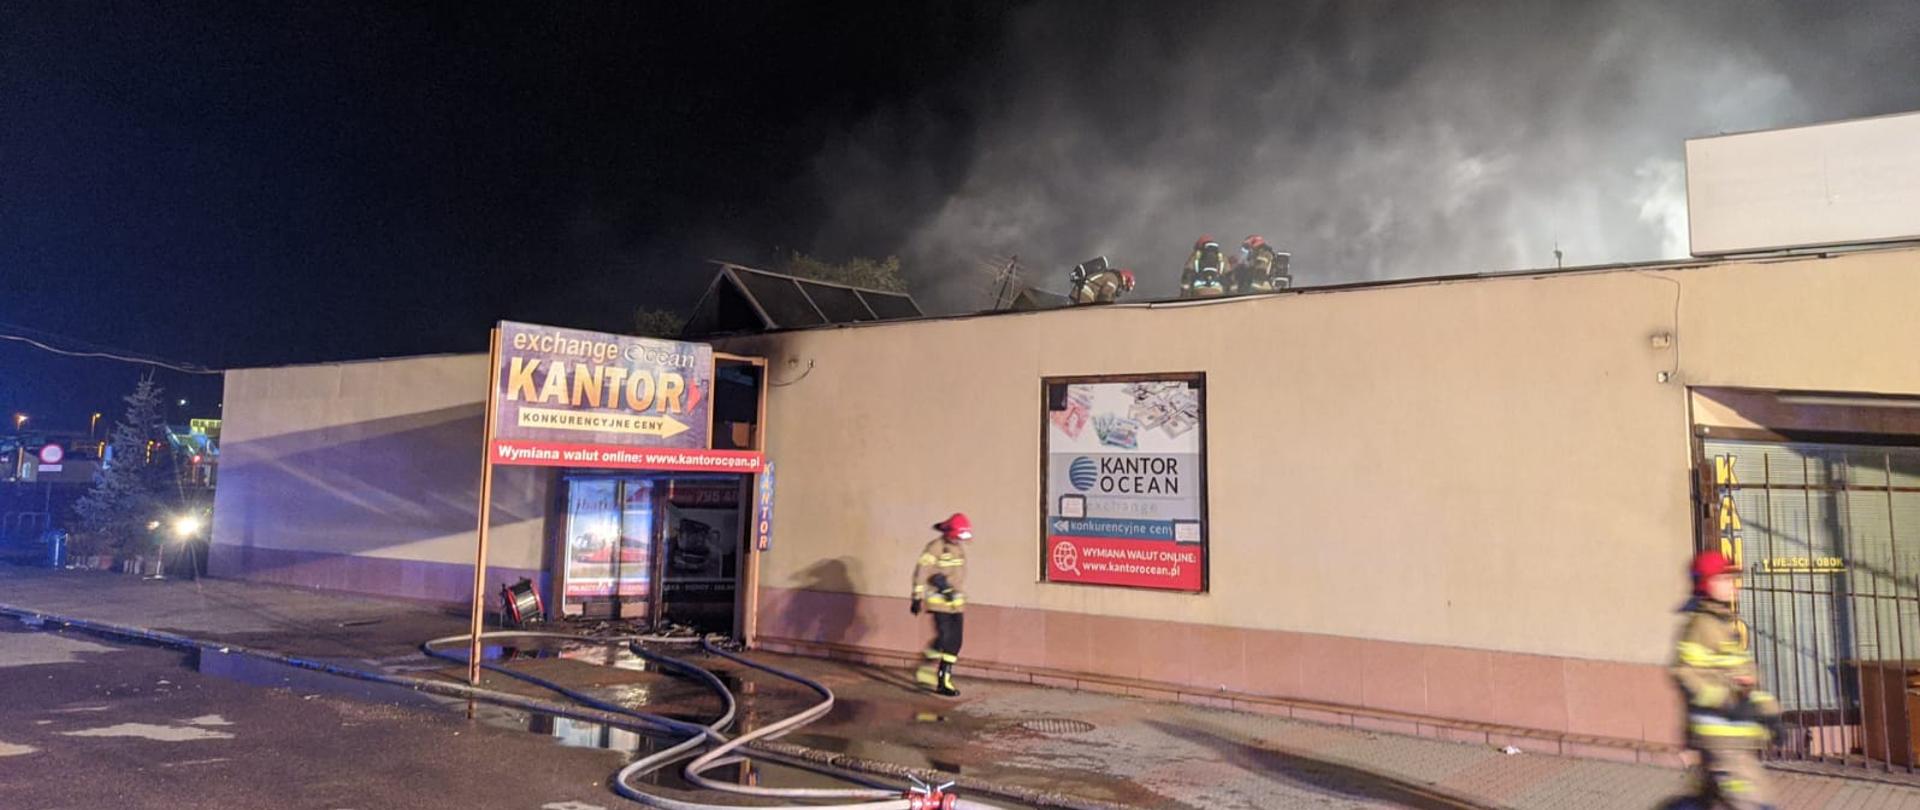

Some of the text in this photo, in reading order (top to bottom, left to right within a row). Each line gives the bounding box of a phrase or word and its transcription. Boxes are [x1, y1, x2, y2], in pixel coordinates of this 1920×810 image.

[513, 331, 696, 368] exchange Ocean
[507, 357, 686, 414] KANTOR
[522, 412, 665, 431] KONKURENCYJNE CENY
[498, 444, 560, 462] Wymiana
[563, 449, 599, 462] walut
[602, 450, 643, 464] online:
[1100, 457, 1178, 476] KANTOR
[1100, 476, 1179, 495] OCEAN
[1070, 519, 1147, 536] konkurencyjne
[1083, 547, 1196, 564] WYMIANA WALUT ONLINE:
[1082, 561, 1181, 577] www.kantorocean.pl
